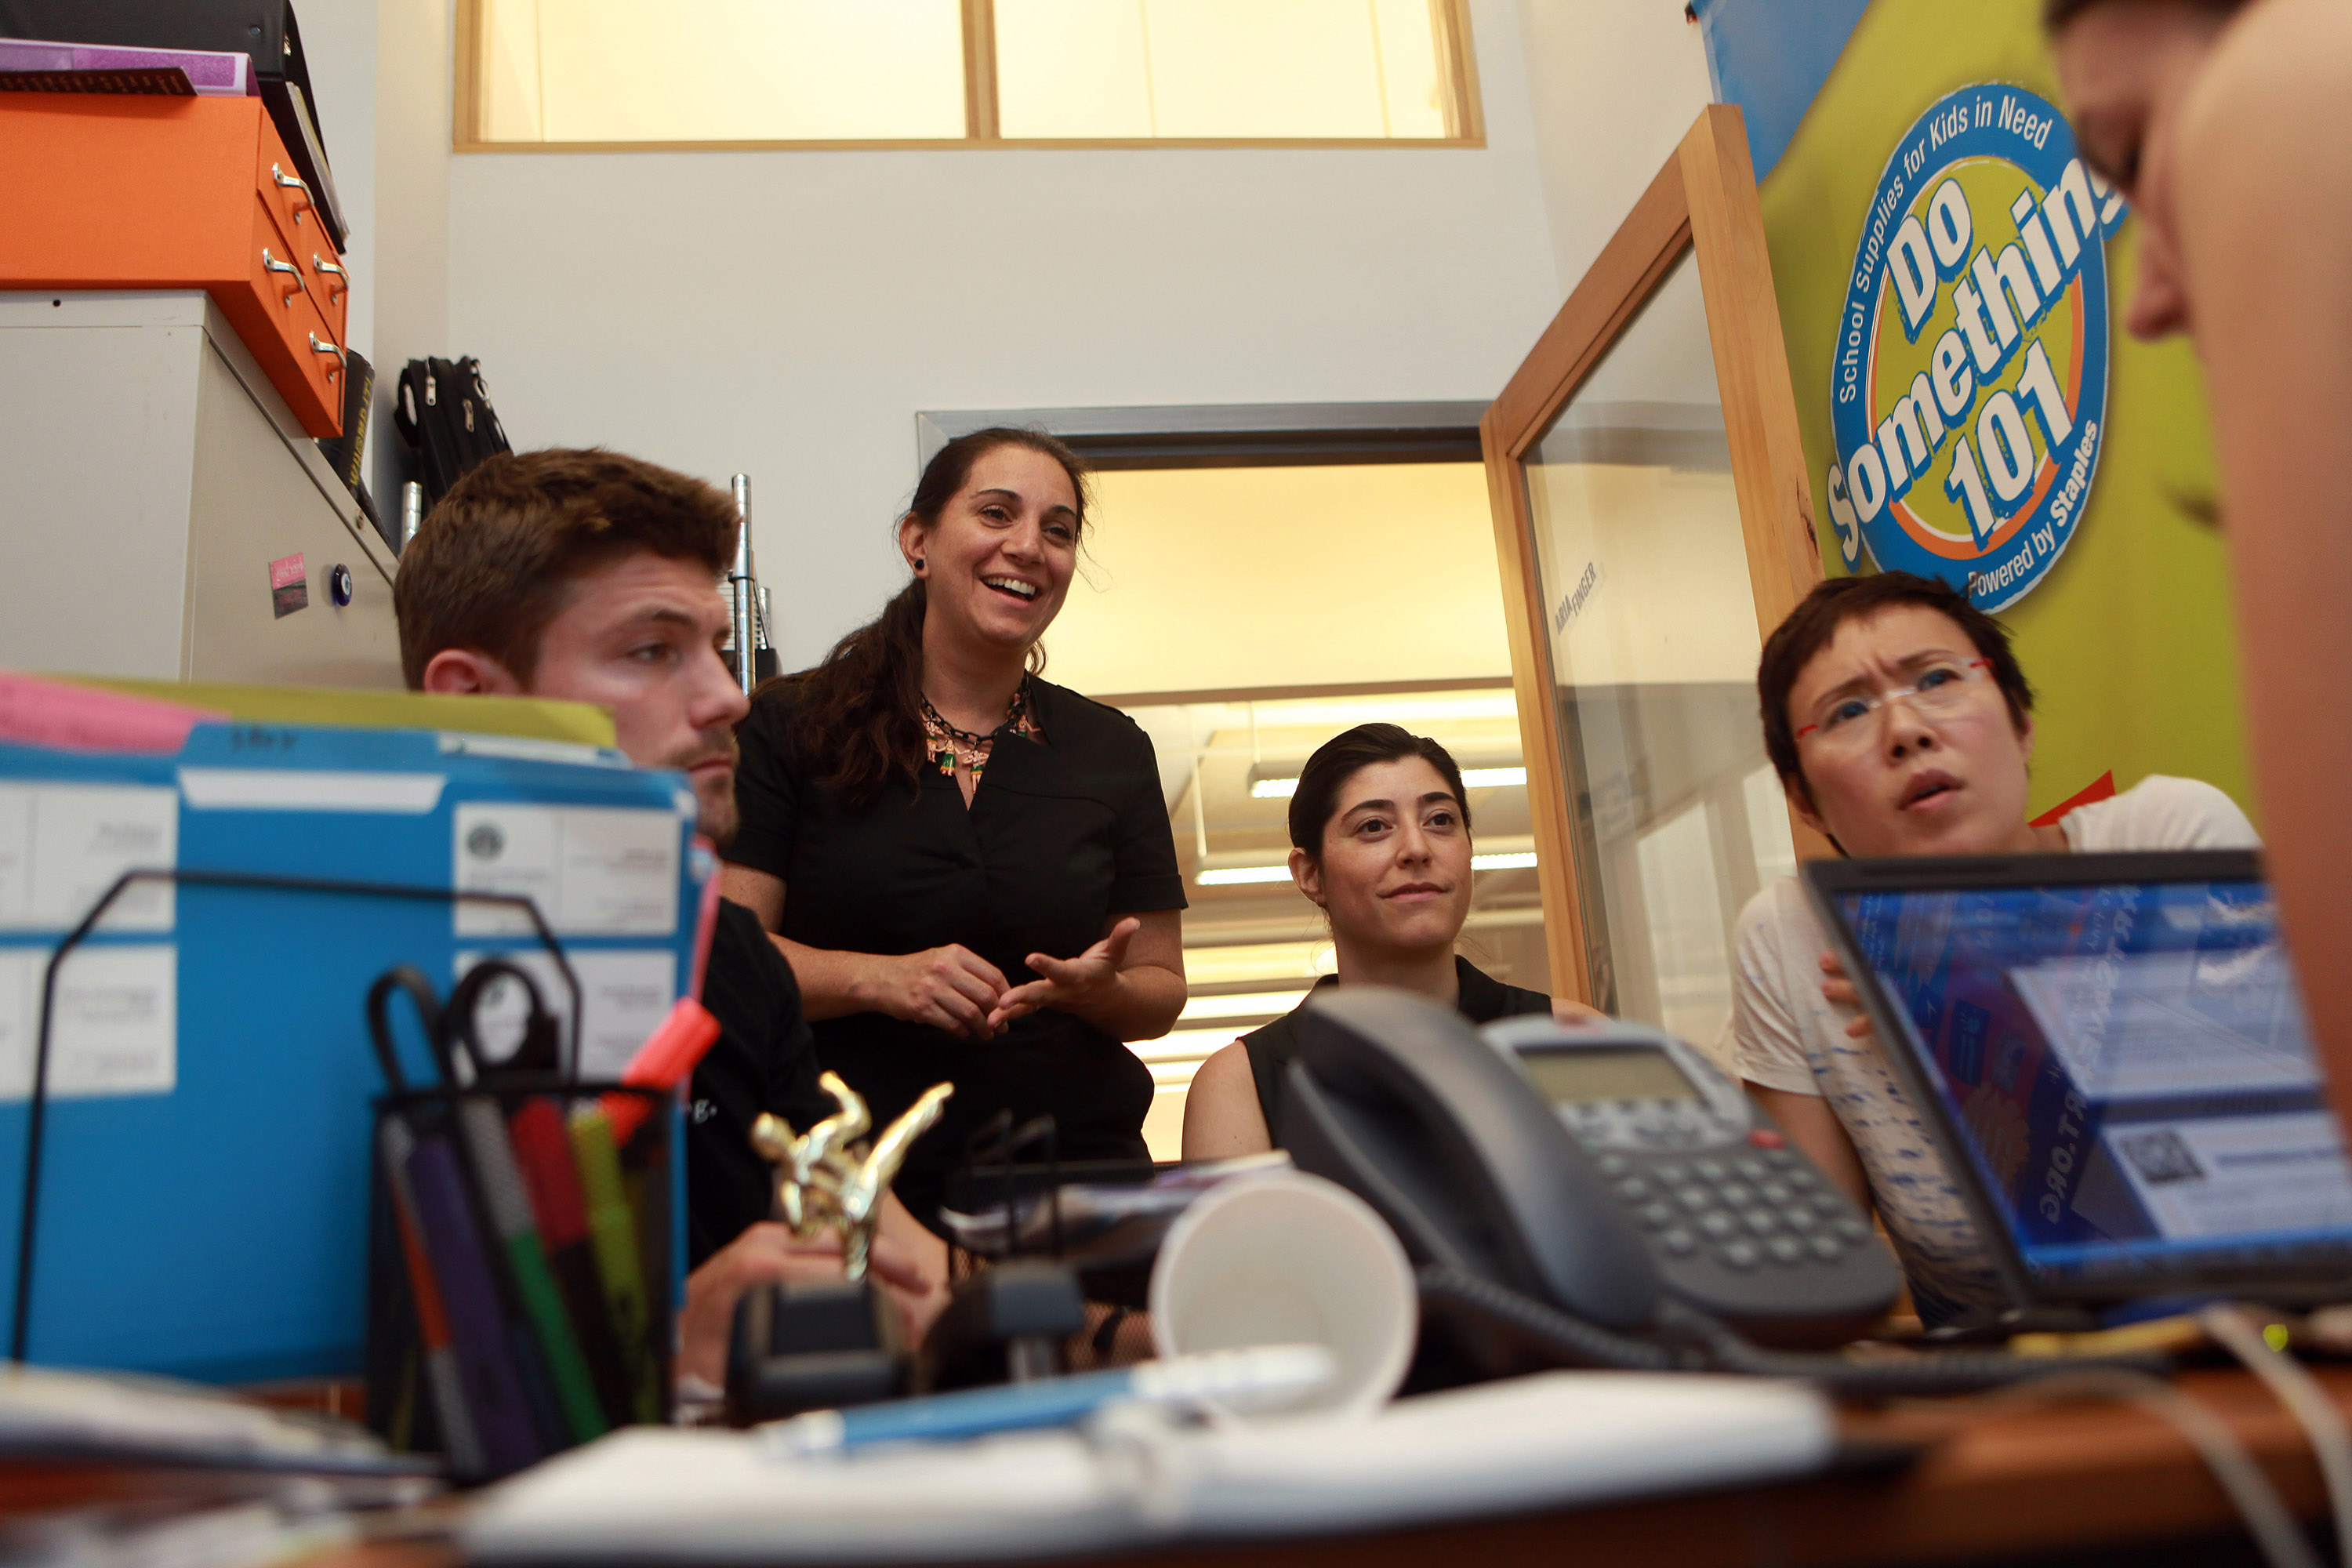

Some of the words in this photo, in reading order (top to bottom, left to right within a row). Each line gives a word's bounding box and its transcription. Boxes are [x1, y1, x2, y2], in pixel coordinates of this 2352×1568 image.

[1839, 301, 1865, 403] School
[1856, 175, 1904, 293] Supplies
[1904, 138, 1925, 181] for
[1929, 104, 1968, 152] Kids
[1975, 95, 1992, 128] in
[1998, 95, 2053, 151] Need
[1947, 343, 2073, 538] 101
[1968, 540, 2034, 598] Powered
[2031, 521, 2056, 556] by
[2050, 419, 2097, 527] Staples
[1555, 593, 1573, 636] ARIA
[1571, 561, 1596, 617] FINGER
